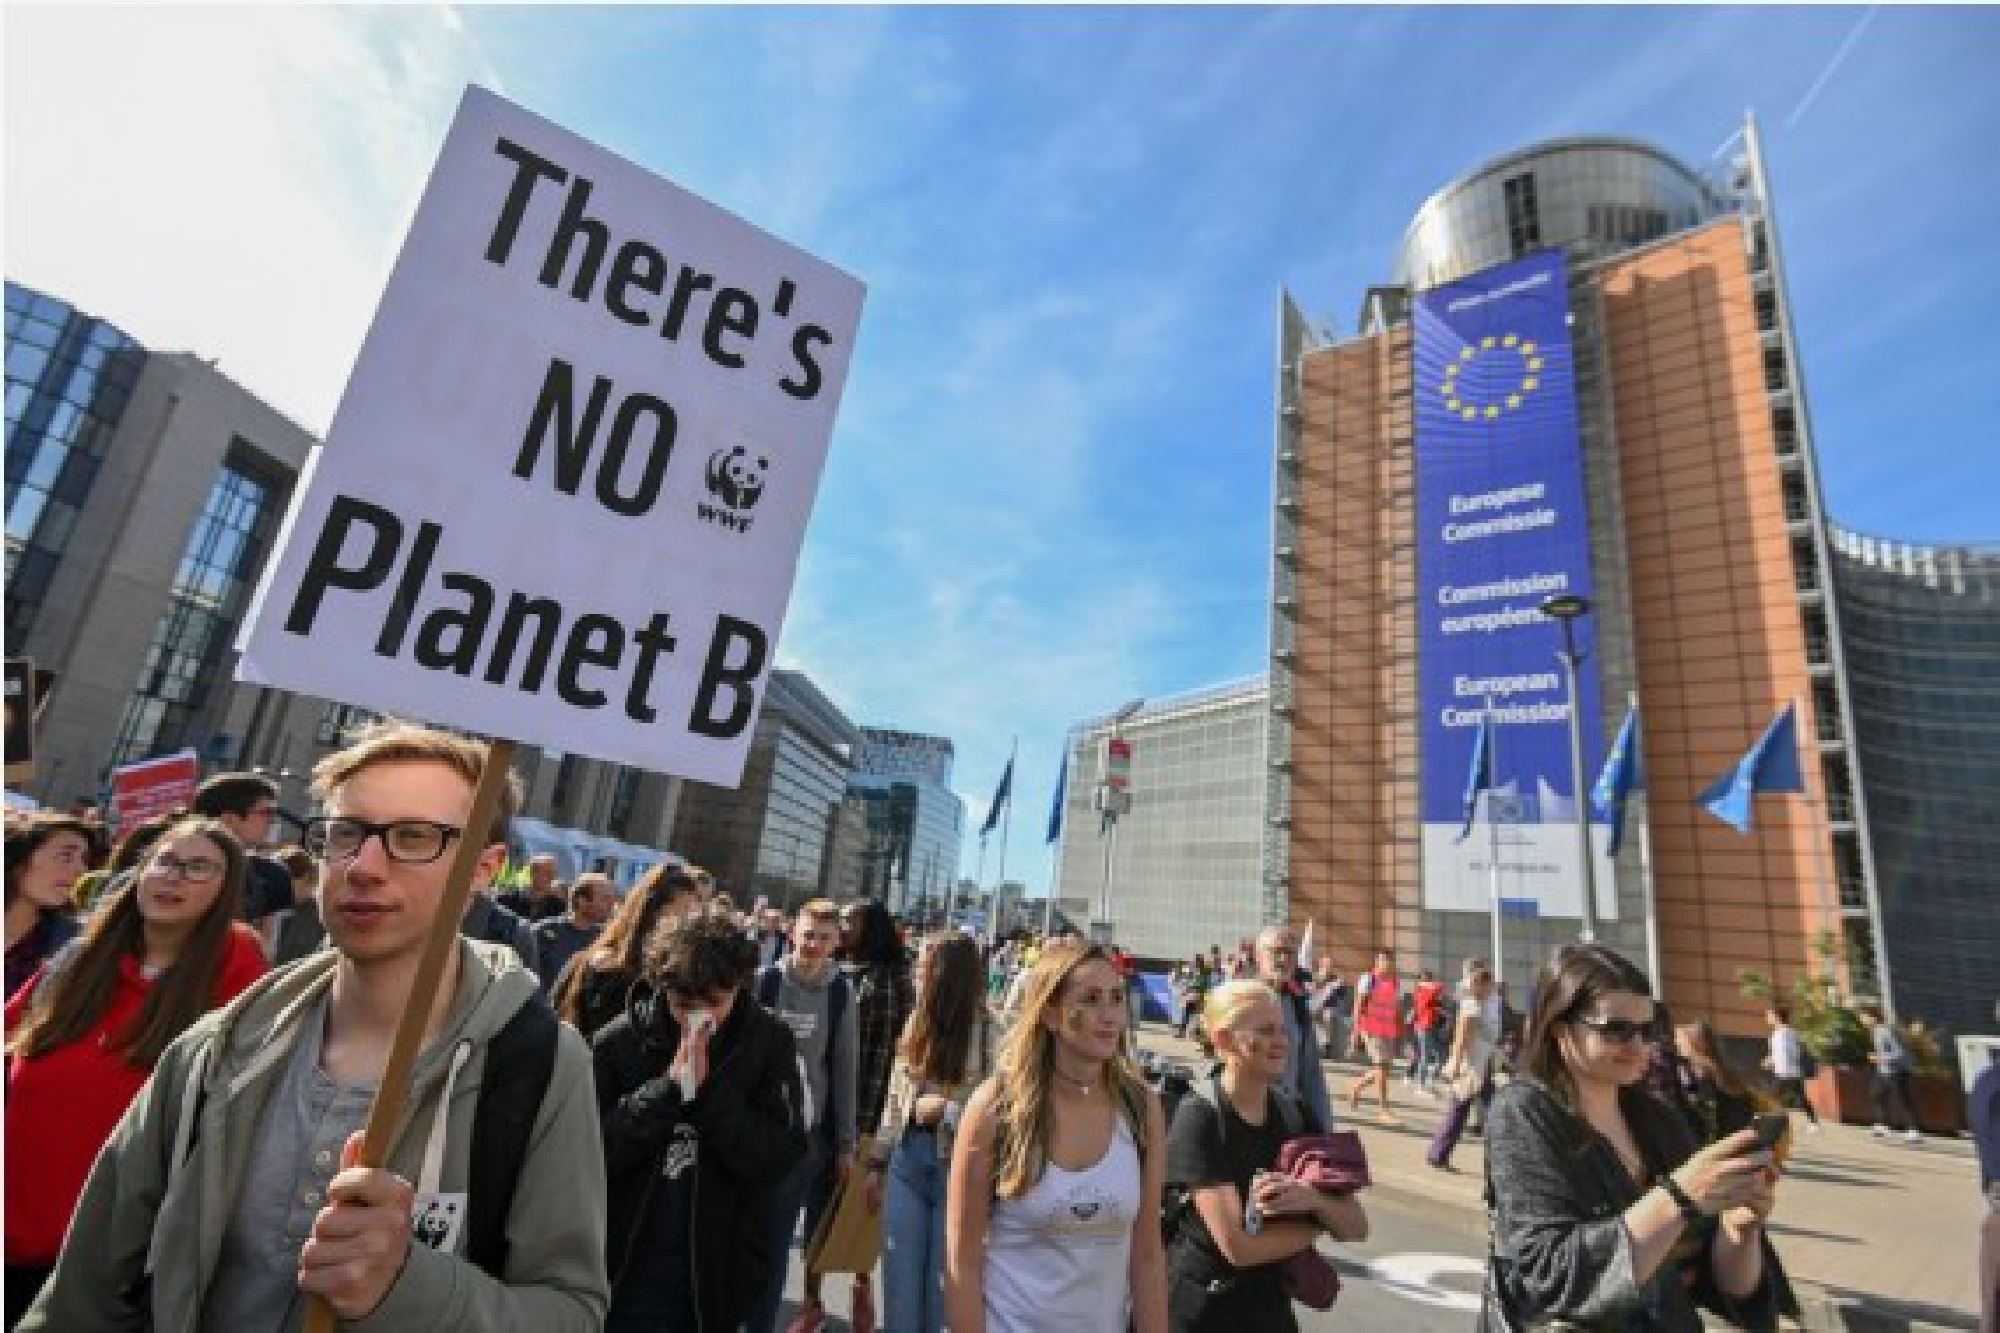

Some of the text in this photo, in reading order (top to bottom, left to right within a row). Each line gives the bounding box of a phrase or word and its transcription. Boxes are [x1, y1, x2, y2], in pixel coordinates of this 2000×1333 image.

[483, 137, 833, 401] There's
[512, 357, 678, 518] NO
[1450, 483, 1545, 514] Europese
[696, 503, 754, 535] WWF
[1443, 509, 1555, 542] Commissie
[1439, 574, 1569, 604] Commission
[283, 494, 768, 740] Planet B
[1454, 673, 1559, 697] European
